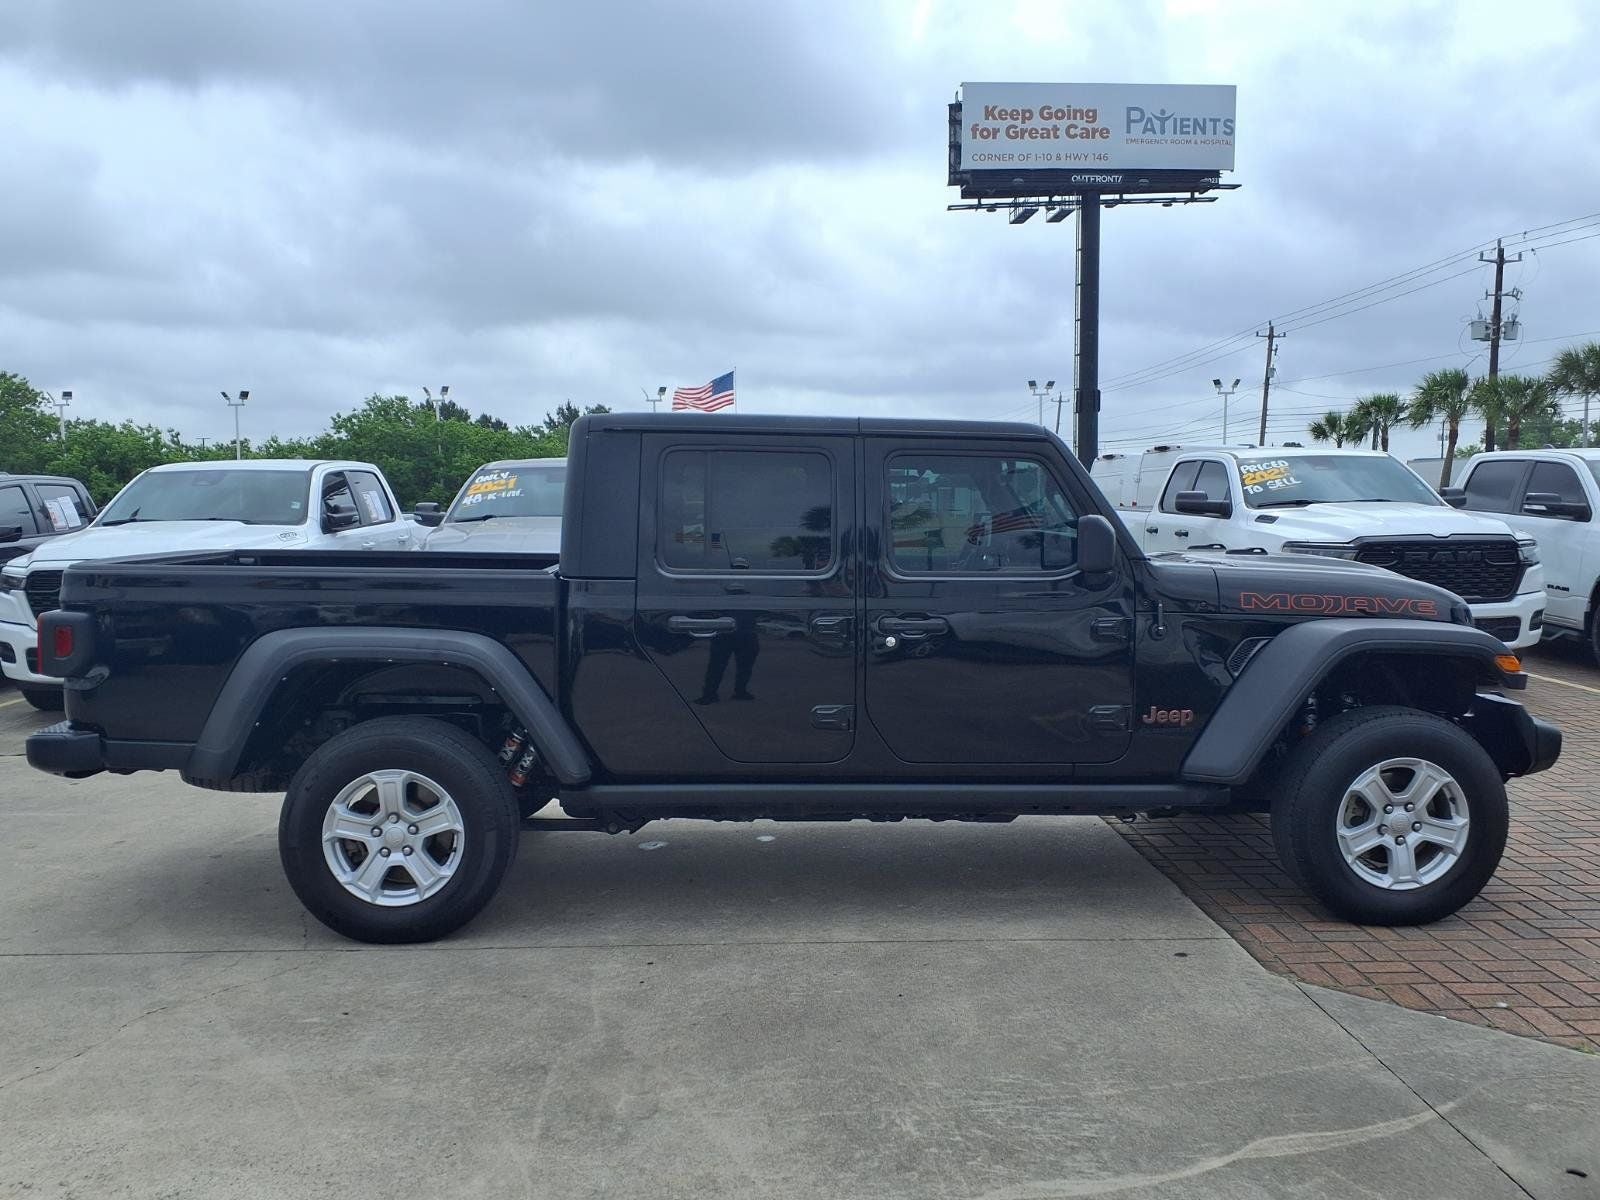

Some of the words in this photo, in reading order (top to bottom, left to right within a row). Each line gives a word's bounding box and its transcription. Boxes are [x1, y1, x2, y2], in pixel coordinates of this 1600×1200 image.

[984, 105, 1034, 124] Keep
[1039, 105, 1098, 123] Going
[970, 124, 1000, 139] for
[1005, 124, 1060, 140] Great
[1065, 124, 1111, 139] Care
[971, 153, 1015, 162] CORNER
[1018, 153, 1032, 161] OF
[1035, 153, 1053, 161] I-10
[1056, 153, 1062, 161] &
[1065, 153, 1089, 161] HWY
[1093, 153, 1109, 161] 146
[1240, 460, 1289, 474] PRICED
[1243, 485, 1263, 494] TO
[1266, 477, 1302, 489] SELL
[1240, 592, 1437, 615] MOJAVE
[1142, 705, 1194, 726] Jeep
